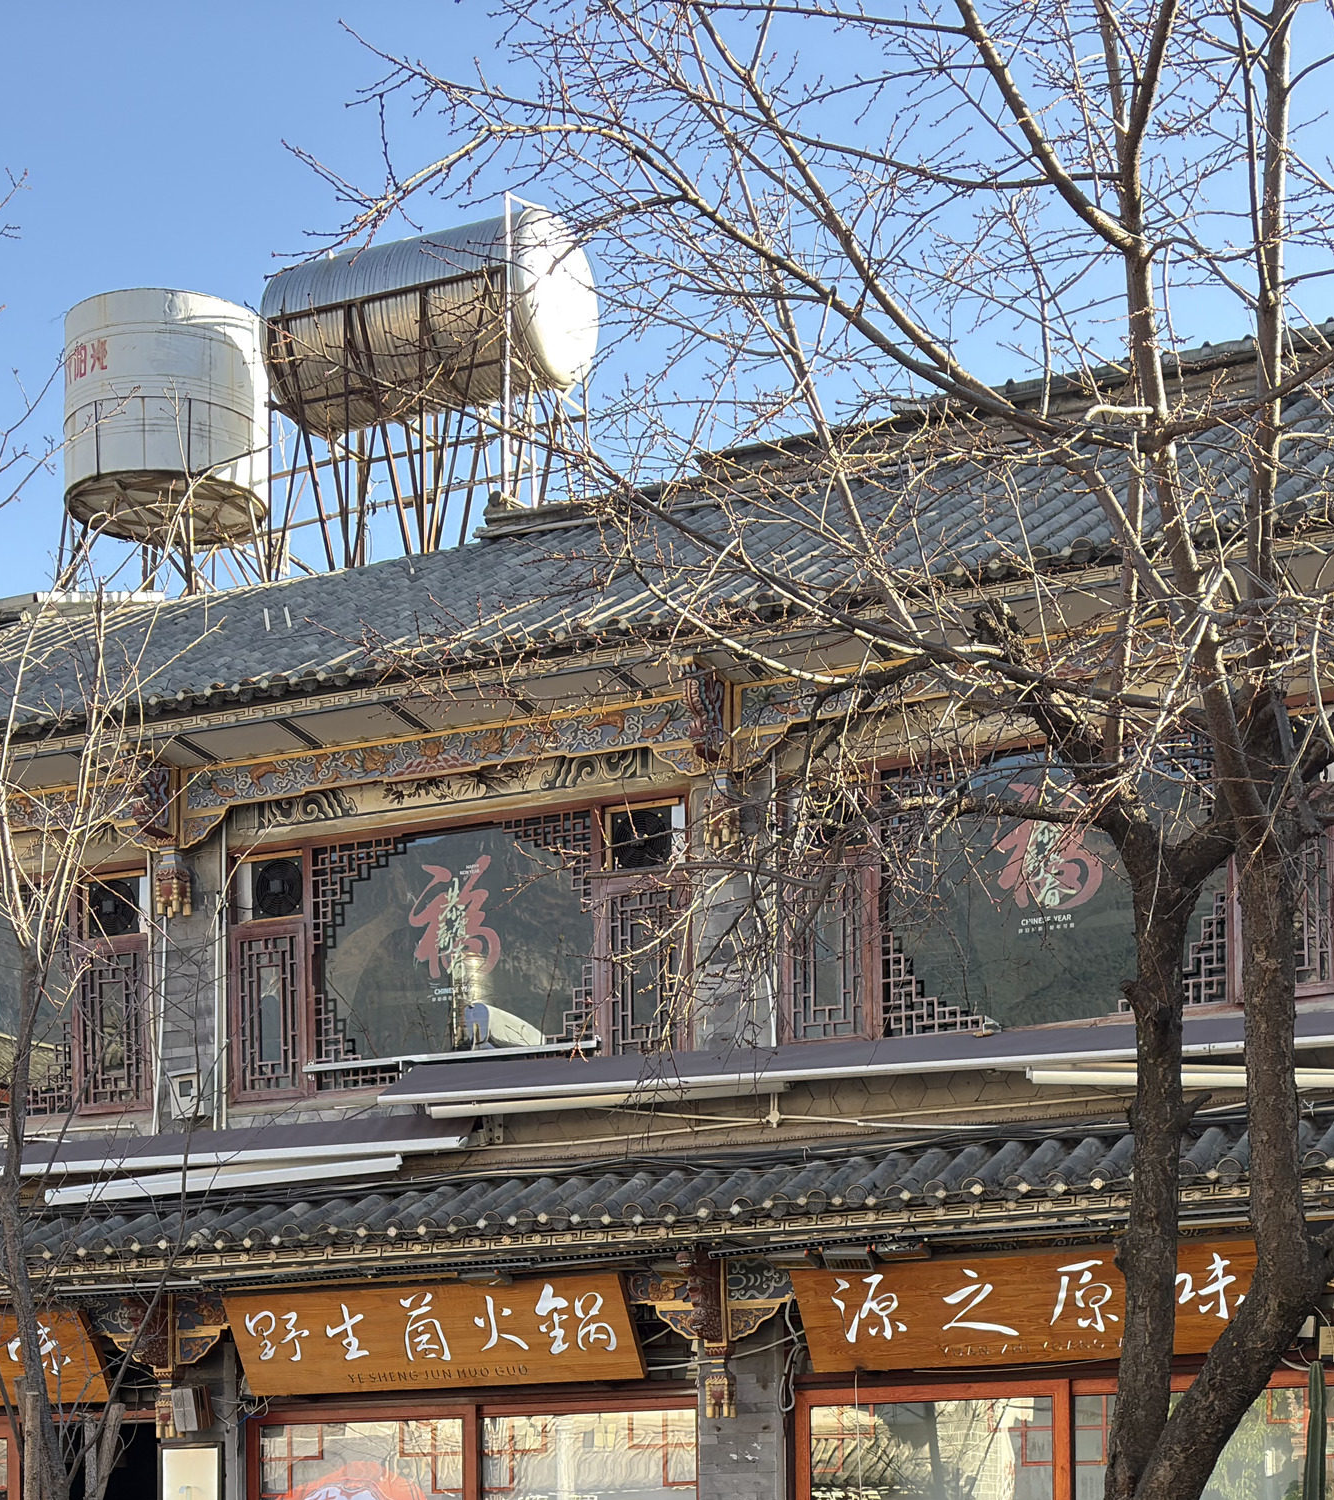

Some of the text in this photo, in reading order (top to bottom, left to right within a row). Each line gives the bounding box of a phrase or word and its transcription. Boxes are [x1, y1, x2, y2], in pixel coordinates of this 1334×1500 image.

[409, 855, 501, 979] 福
[1054, 913, 1072, 923] YEAR
[244, 1282, 618, 1363] 野生菌火锅
[832, 1251, 1246, 1344] 源之原味
[348, 1364, 530, 1385] YE SHENG JUN HUO GUO
